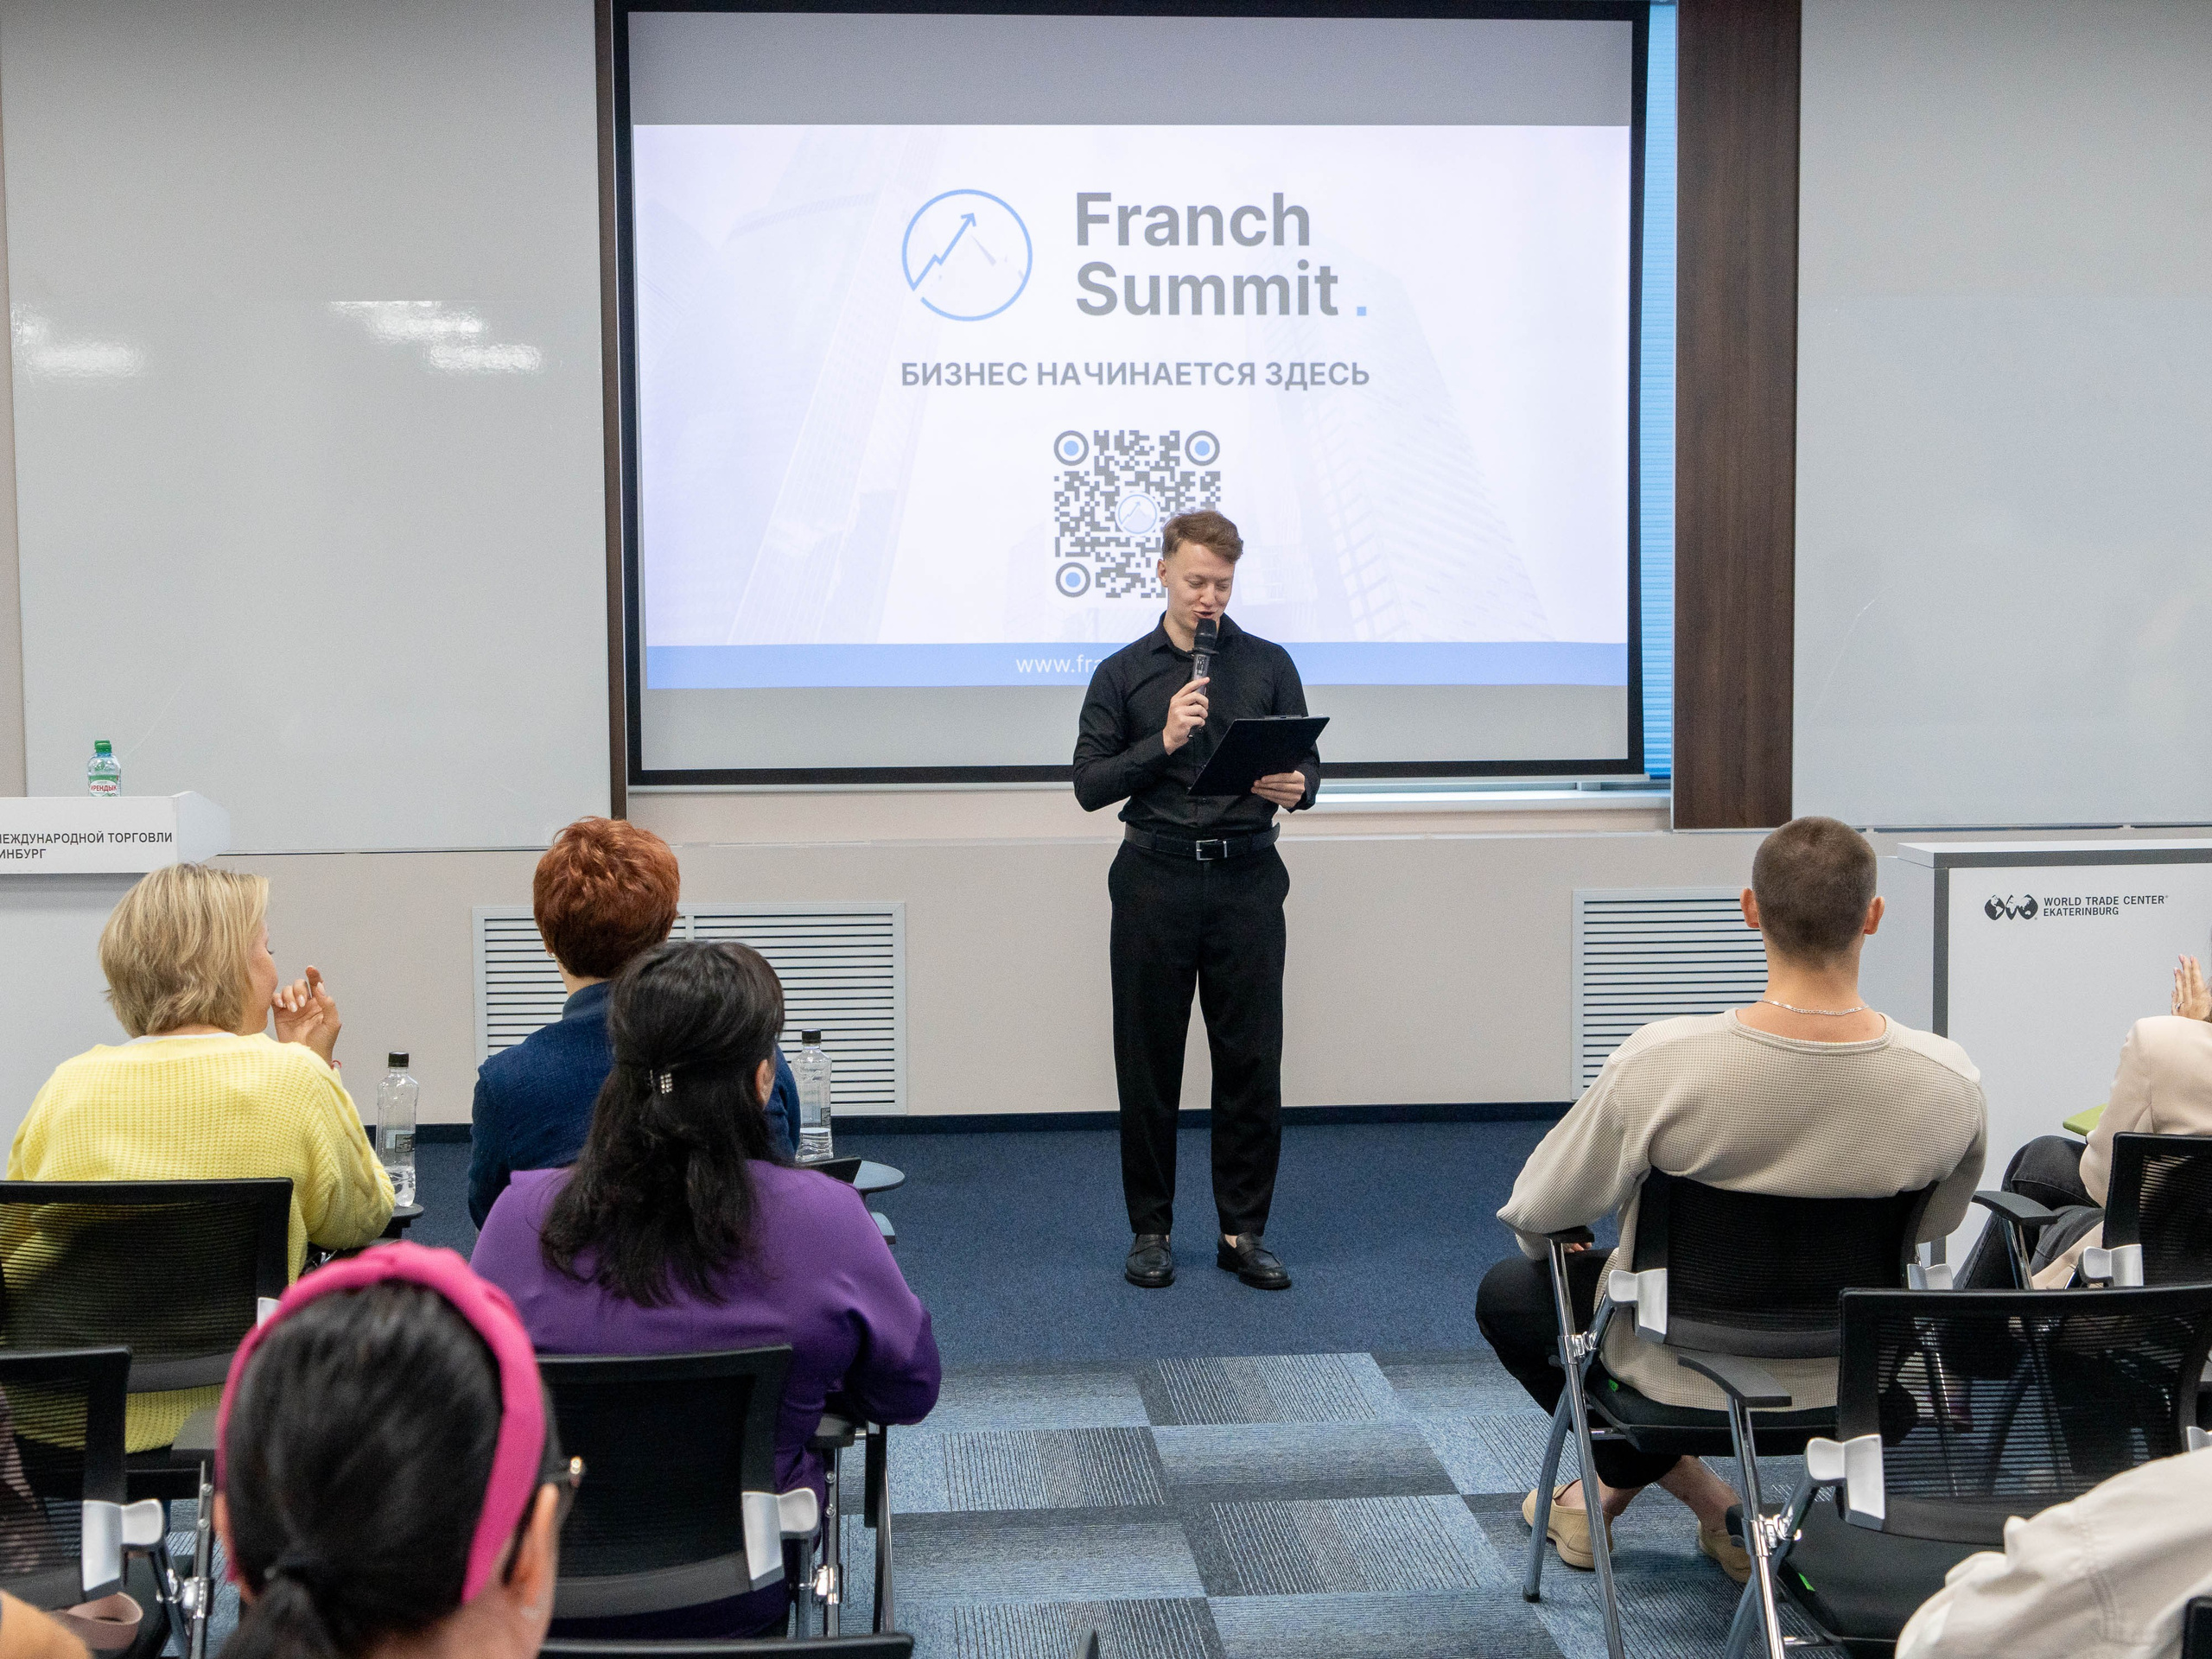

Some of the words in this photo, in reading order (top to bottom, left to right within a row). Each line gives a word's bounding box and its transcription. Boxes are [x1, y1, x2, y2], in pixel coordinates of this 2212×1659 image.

[1076, 192, 1310, 247] Franch
[901, 362, 1028, 386] БИЗНЕС
[1038, 361, 1255, 386] НАЧИНАЕТСЯ
[1265, 361, 1370, 391] ЗДЕСЬ
[0, 830, 105, 846] ЕЖДУНАРОДНОЙ
[108, 832, 173, 843] ТОРГОВЛИ
[2044, 897, 2082, 906] WORLD
[2085, 896, 2120, 906] TRADE
[2123, 895, 2164, 905] CENTER
[2044, 906, 2119, 917] EKATERINBURG
